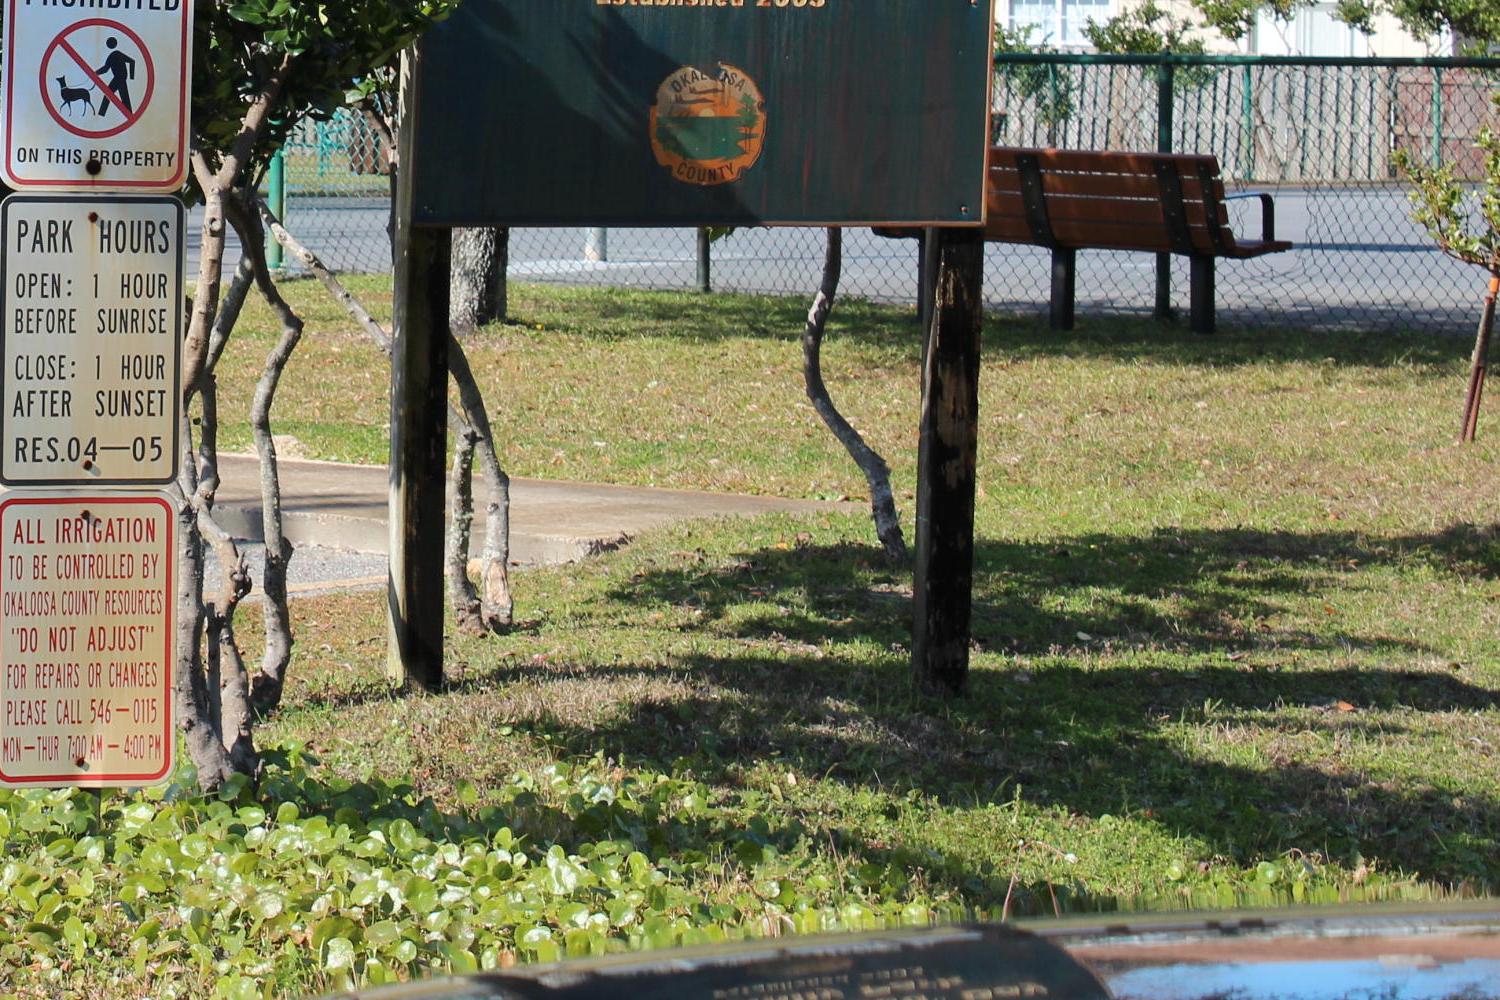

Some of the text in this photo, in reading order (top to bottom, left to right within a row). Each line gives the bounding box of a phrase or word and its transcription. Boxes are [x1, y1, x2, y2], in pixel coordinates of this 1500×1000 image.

[17, 148, 176, 168] ON THIS PROPERTY
[676, 161, 734, 182] COUNTY
[17, 220, 170, 254] PARK HOURS
[15, 273, 167, 298] OPEN: 1 HOUR
[15, 309, 167, 334] BEFORE SUNRISE
[15, 355, 165, 380] CLOSE: 1 HOUR
[13, 390, 166, 417] AFTER SUNSET
[13, 518, 156, 544] ALL IRRIGATION
[9, 554, 158, 580] TO BE CONTROLLED BY
[4, 590, 162, 617] OKALOOSA COUNTY RESOURCES
[11, 626, 155, 653] "DO NOT ADJUST"
[7, 662, 157, 689] FOR REPAIRS OR CHANGES
[7, 700, 47, 726] PLEASE
[56, 699, 82, 725] CALL
[67, 736, 86, 761] 7:00
[91, 735, 103, 760] AM
[124, 735, 144, 760] 4:00
[149, 735, 160, 760] PM
